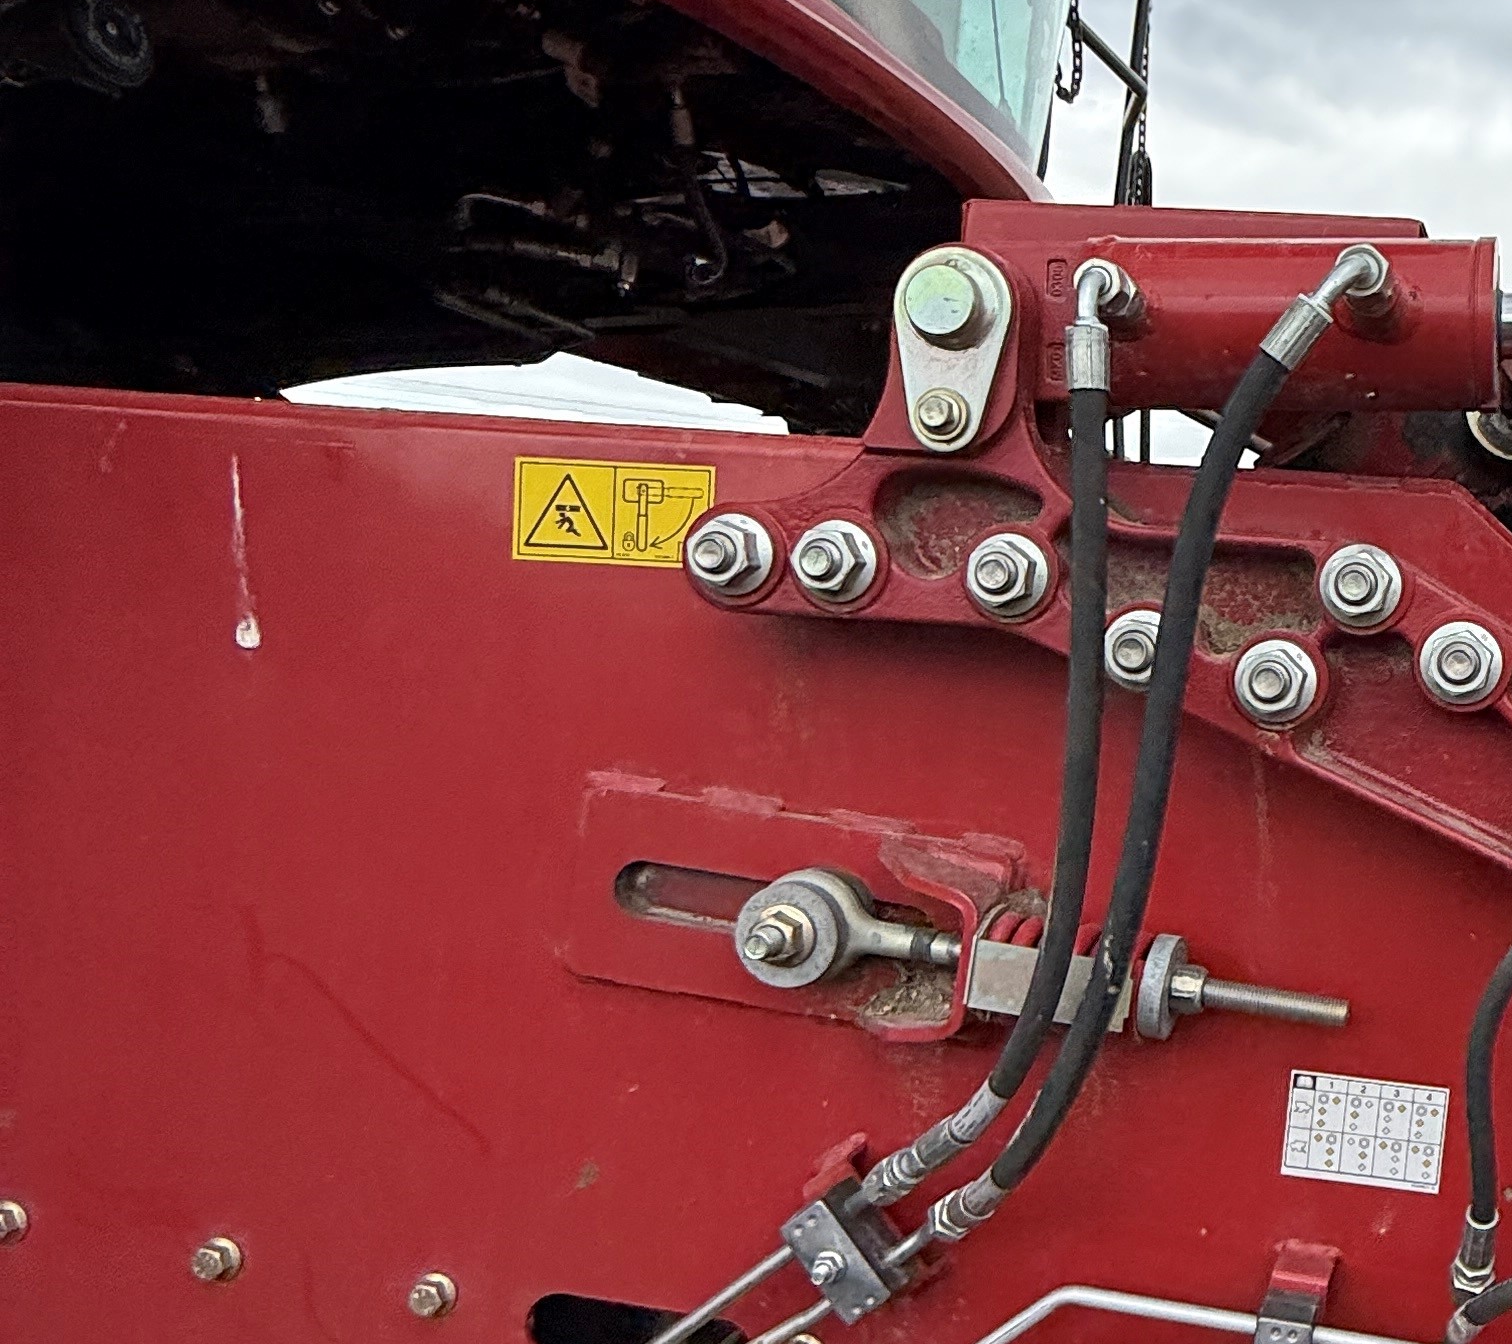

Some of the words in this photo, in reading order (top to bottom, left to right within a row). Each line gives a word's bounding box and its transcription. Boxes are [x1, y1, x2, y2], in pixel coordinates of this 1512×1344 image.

[1329, 1081, 1334, 1089] 1
[1360, 1085, 1367, 1094] 2
[1393, 1089, 1400, 1098] 3
[1426, 1093, 1433, 1101] 4
